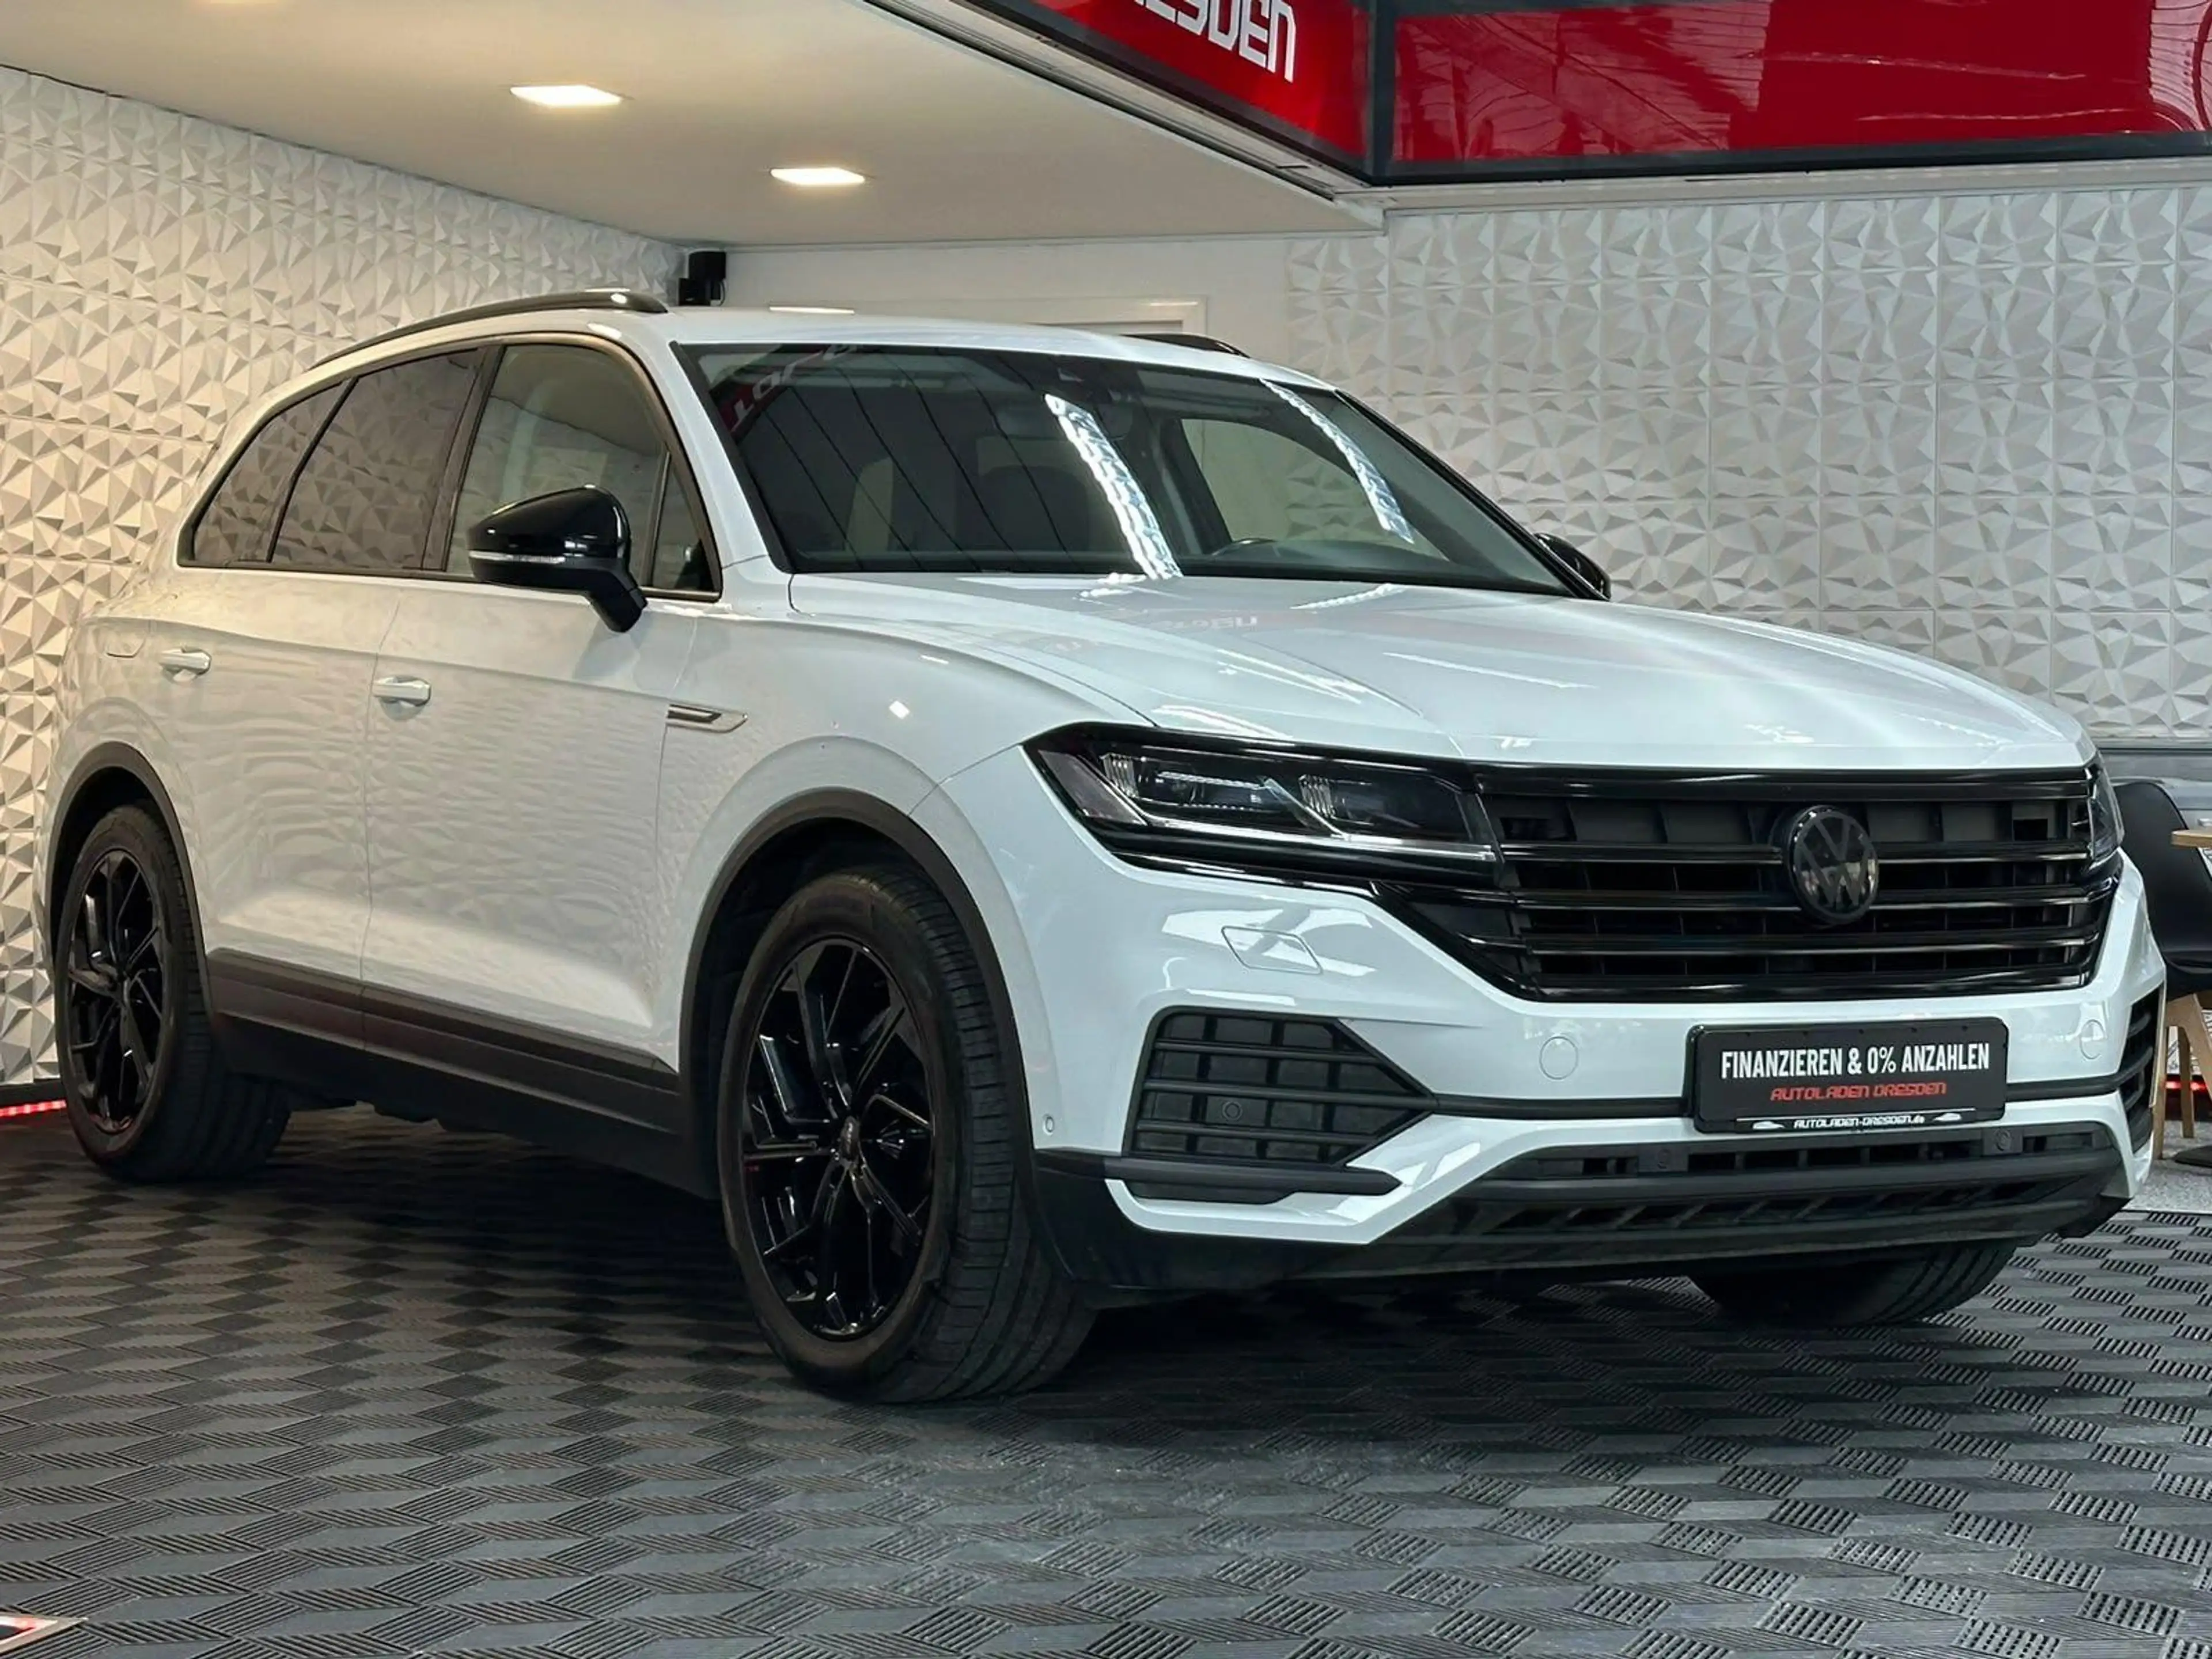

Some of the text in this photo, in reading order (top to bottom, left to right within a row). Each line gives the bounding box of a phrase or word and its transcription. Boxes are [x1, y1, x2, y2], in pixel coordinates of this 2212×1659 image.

[1721, 1043, 1989, 1078] FINANZIEREN & 0% ANZAHLEN
[1770, 1082, 1946, 1101] AUTOLADEN DRESDEN
